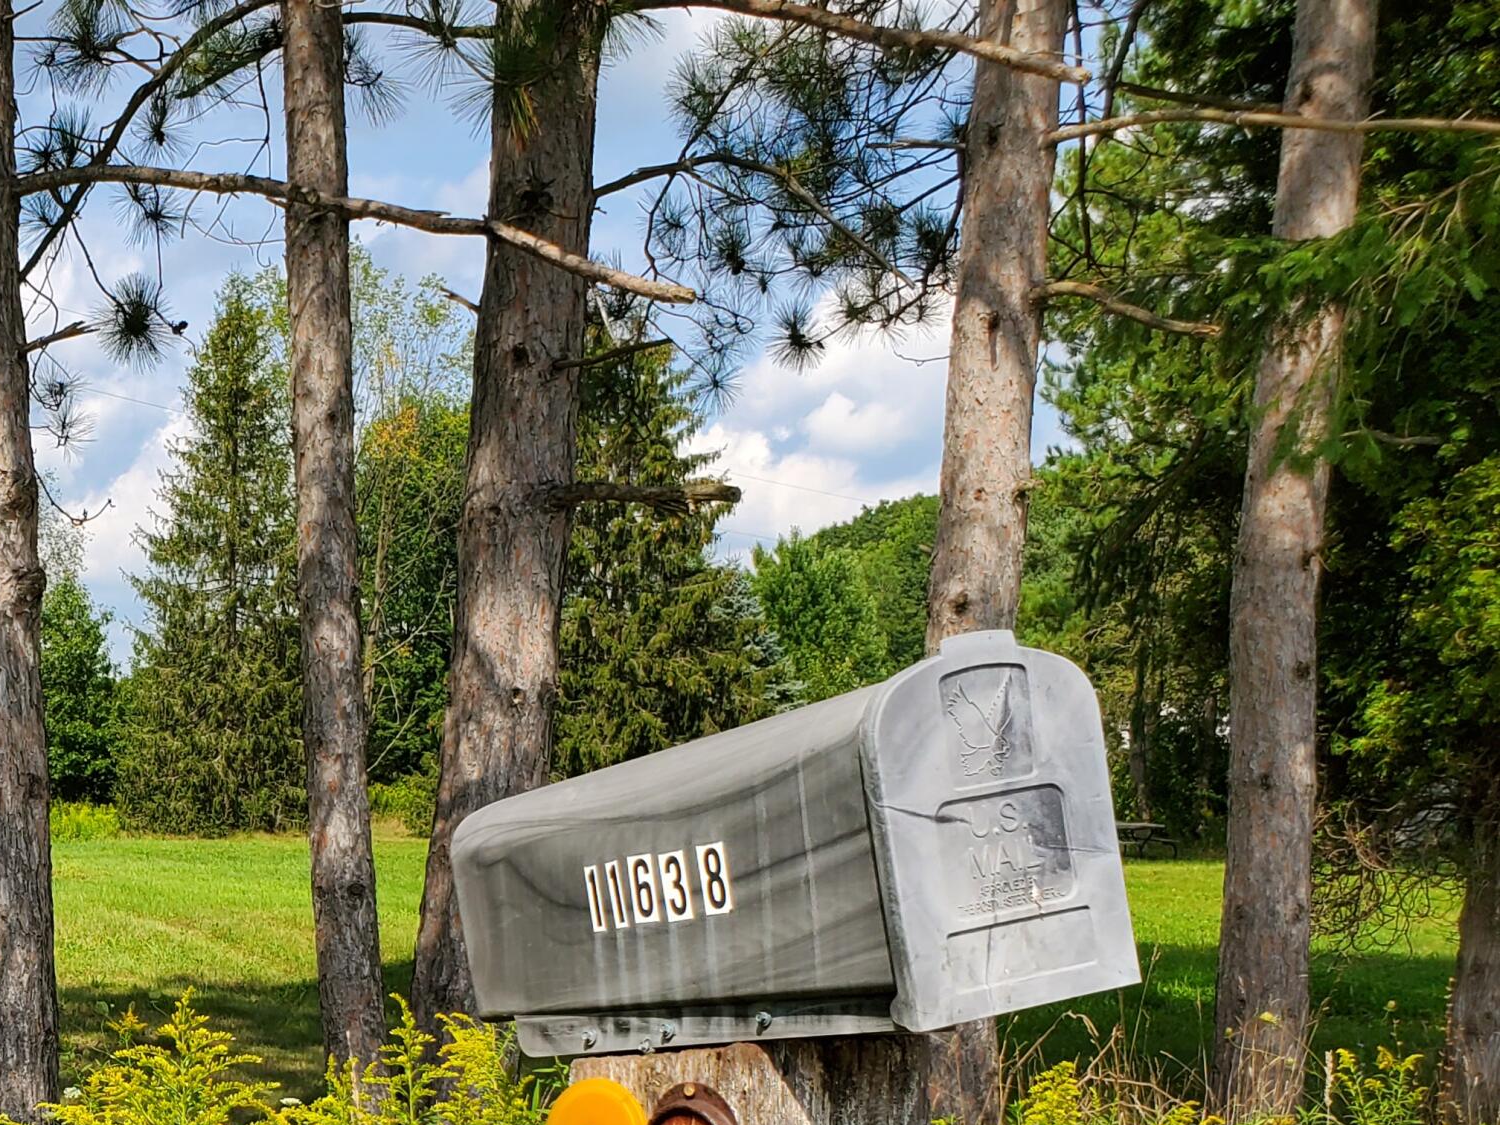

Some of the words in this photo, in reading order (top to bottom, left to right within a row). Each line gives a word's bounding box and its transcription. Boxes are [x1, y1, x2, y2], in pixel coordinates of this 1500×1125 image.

[968, 802, 1027, 839] U.S.
[968, 837, 1042, 880] MAIL
[588, 847, 727, 928] 11638
